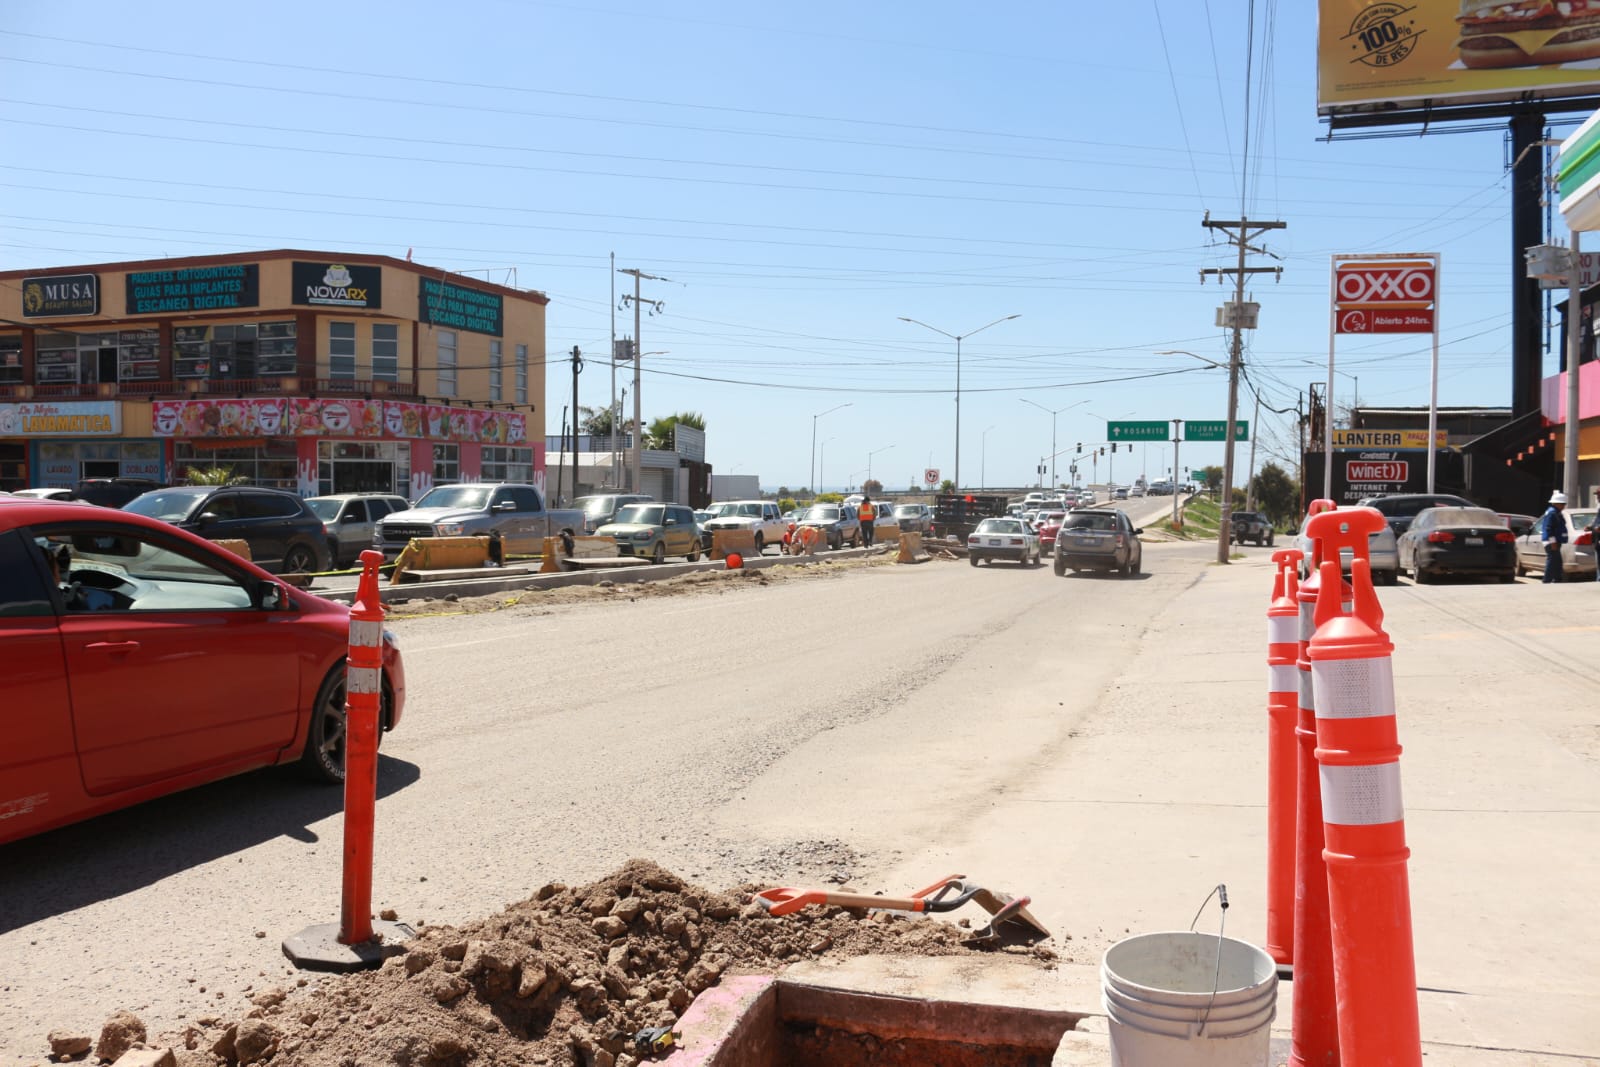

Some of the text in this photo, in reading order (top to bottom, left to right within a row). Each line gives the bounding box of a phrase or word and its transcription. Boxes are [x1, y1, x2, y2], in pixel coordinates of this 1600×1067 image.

[1358, 21, 1412, 52] 100%
[1376, 45, 1409, 64] DE RES
[131, 271, 174, 285] PAQUETES
[1339, 272, 1431, 300] OXXO
[46, 283, 93, 300] MUSA
[134, 280, 241, 299] GUIAS PARA IMPLANTES
[306, 285, 368, 300] NOVARX
[137, 294, 239, 313] ESCANEO DIGITAL
[448, 300, 464, 313] PARA
[428, 308, 466, 327] ESCANEO
[1353, 317, 1430, 331] 24 Abierto 24hrs.
[22, 415, 112, 432] LAVAMATICA
[126, 465, 159, 473] DOBLADO
